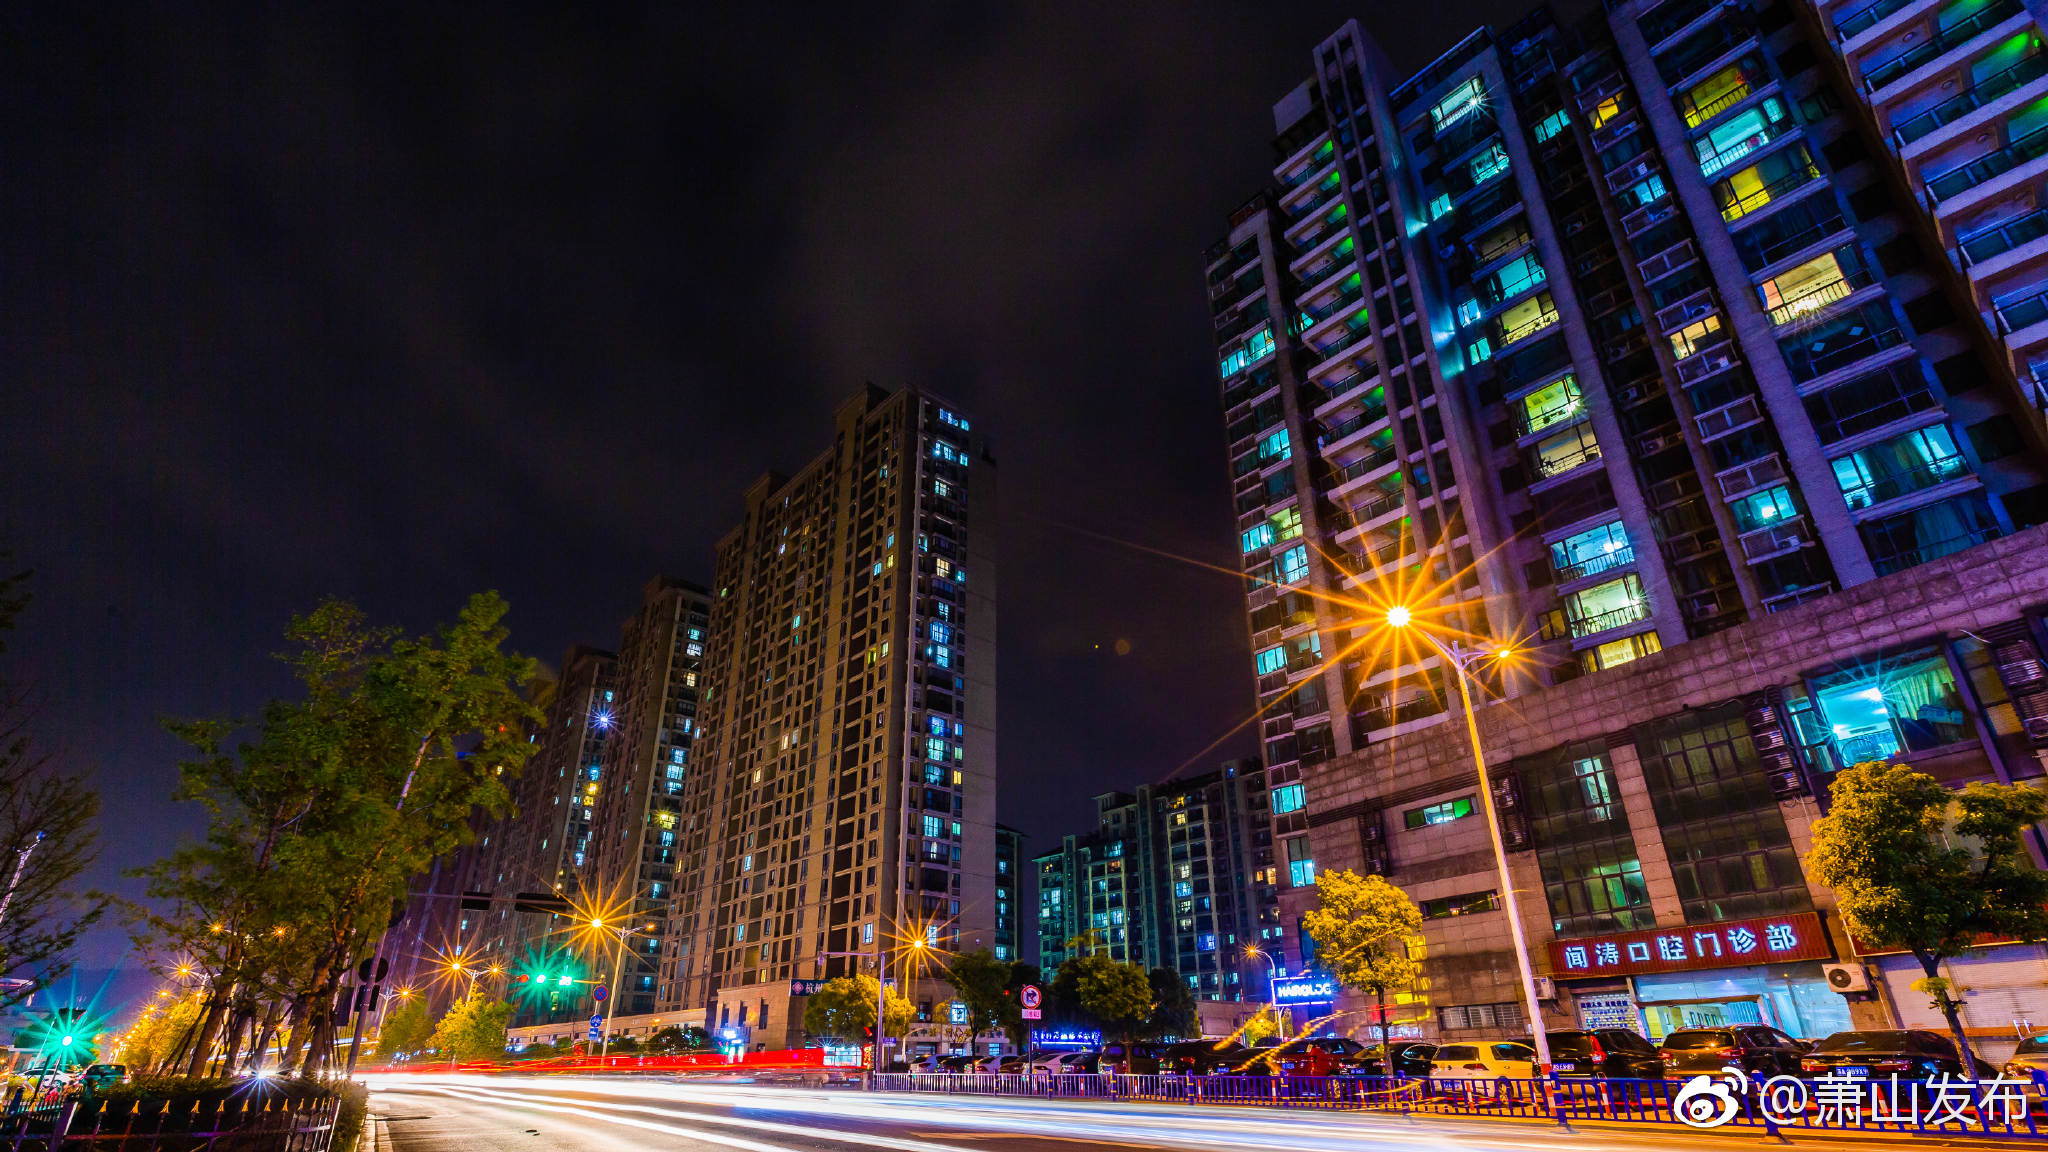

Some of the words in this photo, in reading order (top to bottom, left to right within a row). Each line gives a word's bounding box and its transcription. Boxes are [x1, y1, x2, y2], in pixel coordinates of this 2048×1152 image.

[1565, 924, 1798, 969] 闻涛口腔门诊部
